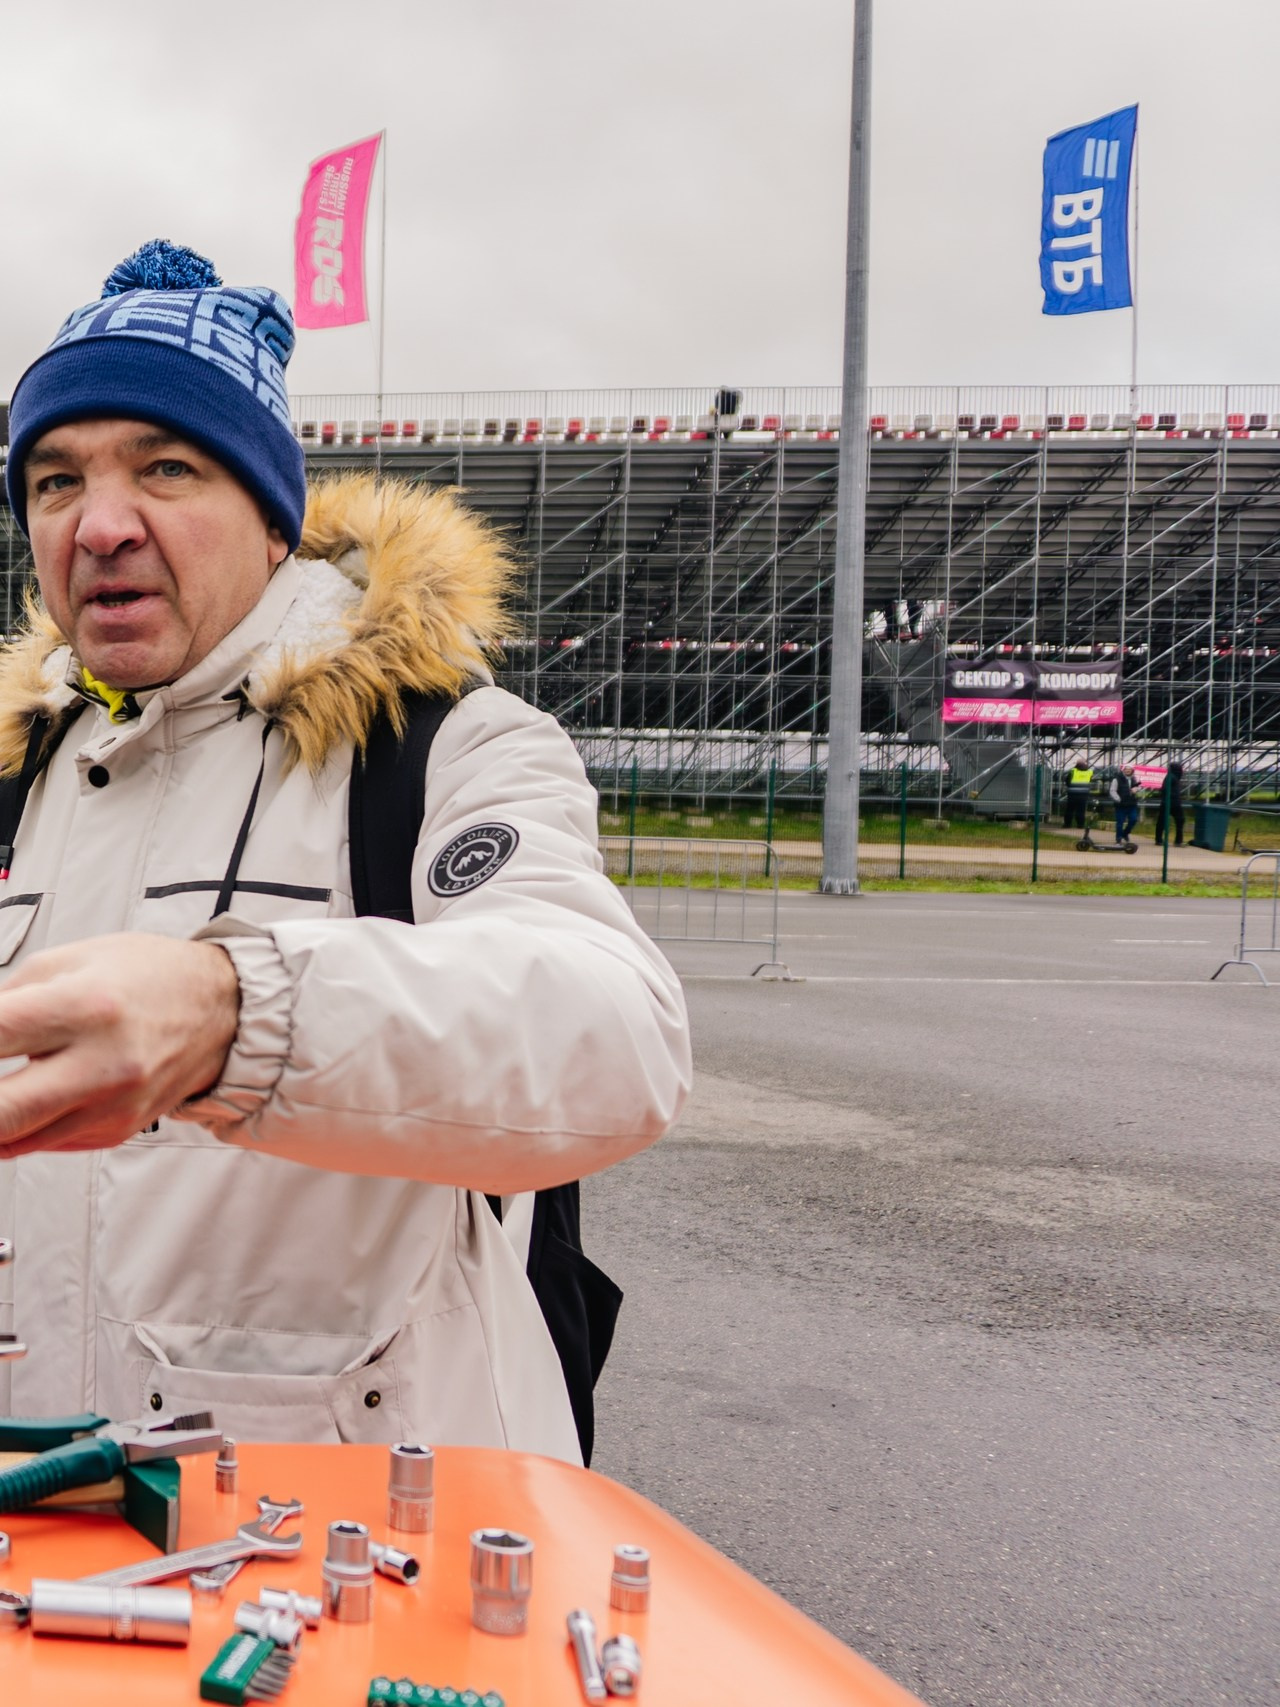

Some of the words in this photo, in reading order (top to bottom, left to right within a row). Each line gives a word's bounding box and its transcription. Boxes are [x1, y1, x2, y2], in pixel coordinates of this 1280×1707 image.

[336, 157, 354, 211] RUSSIAN
[1051, 187, 1104, 295] ВТБ
[312, 216, 344, 306] RDS
[955, 670, 1012, 688] СЕКТОР
[1015, 673, 1024, 689] 3
[1039, 673, 1117, 689] КОМФОРТ
[979, 703, 1024, 718] RDS
[1063, 706, 1101, 719] RDS
